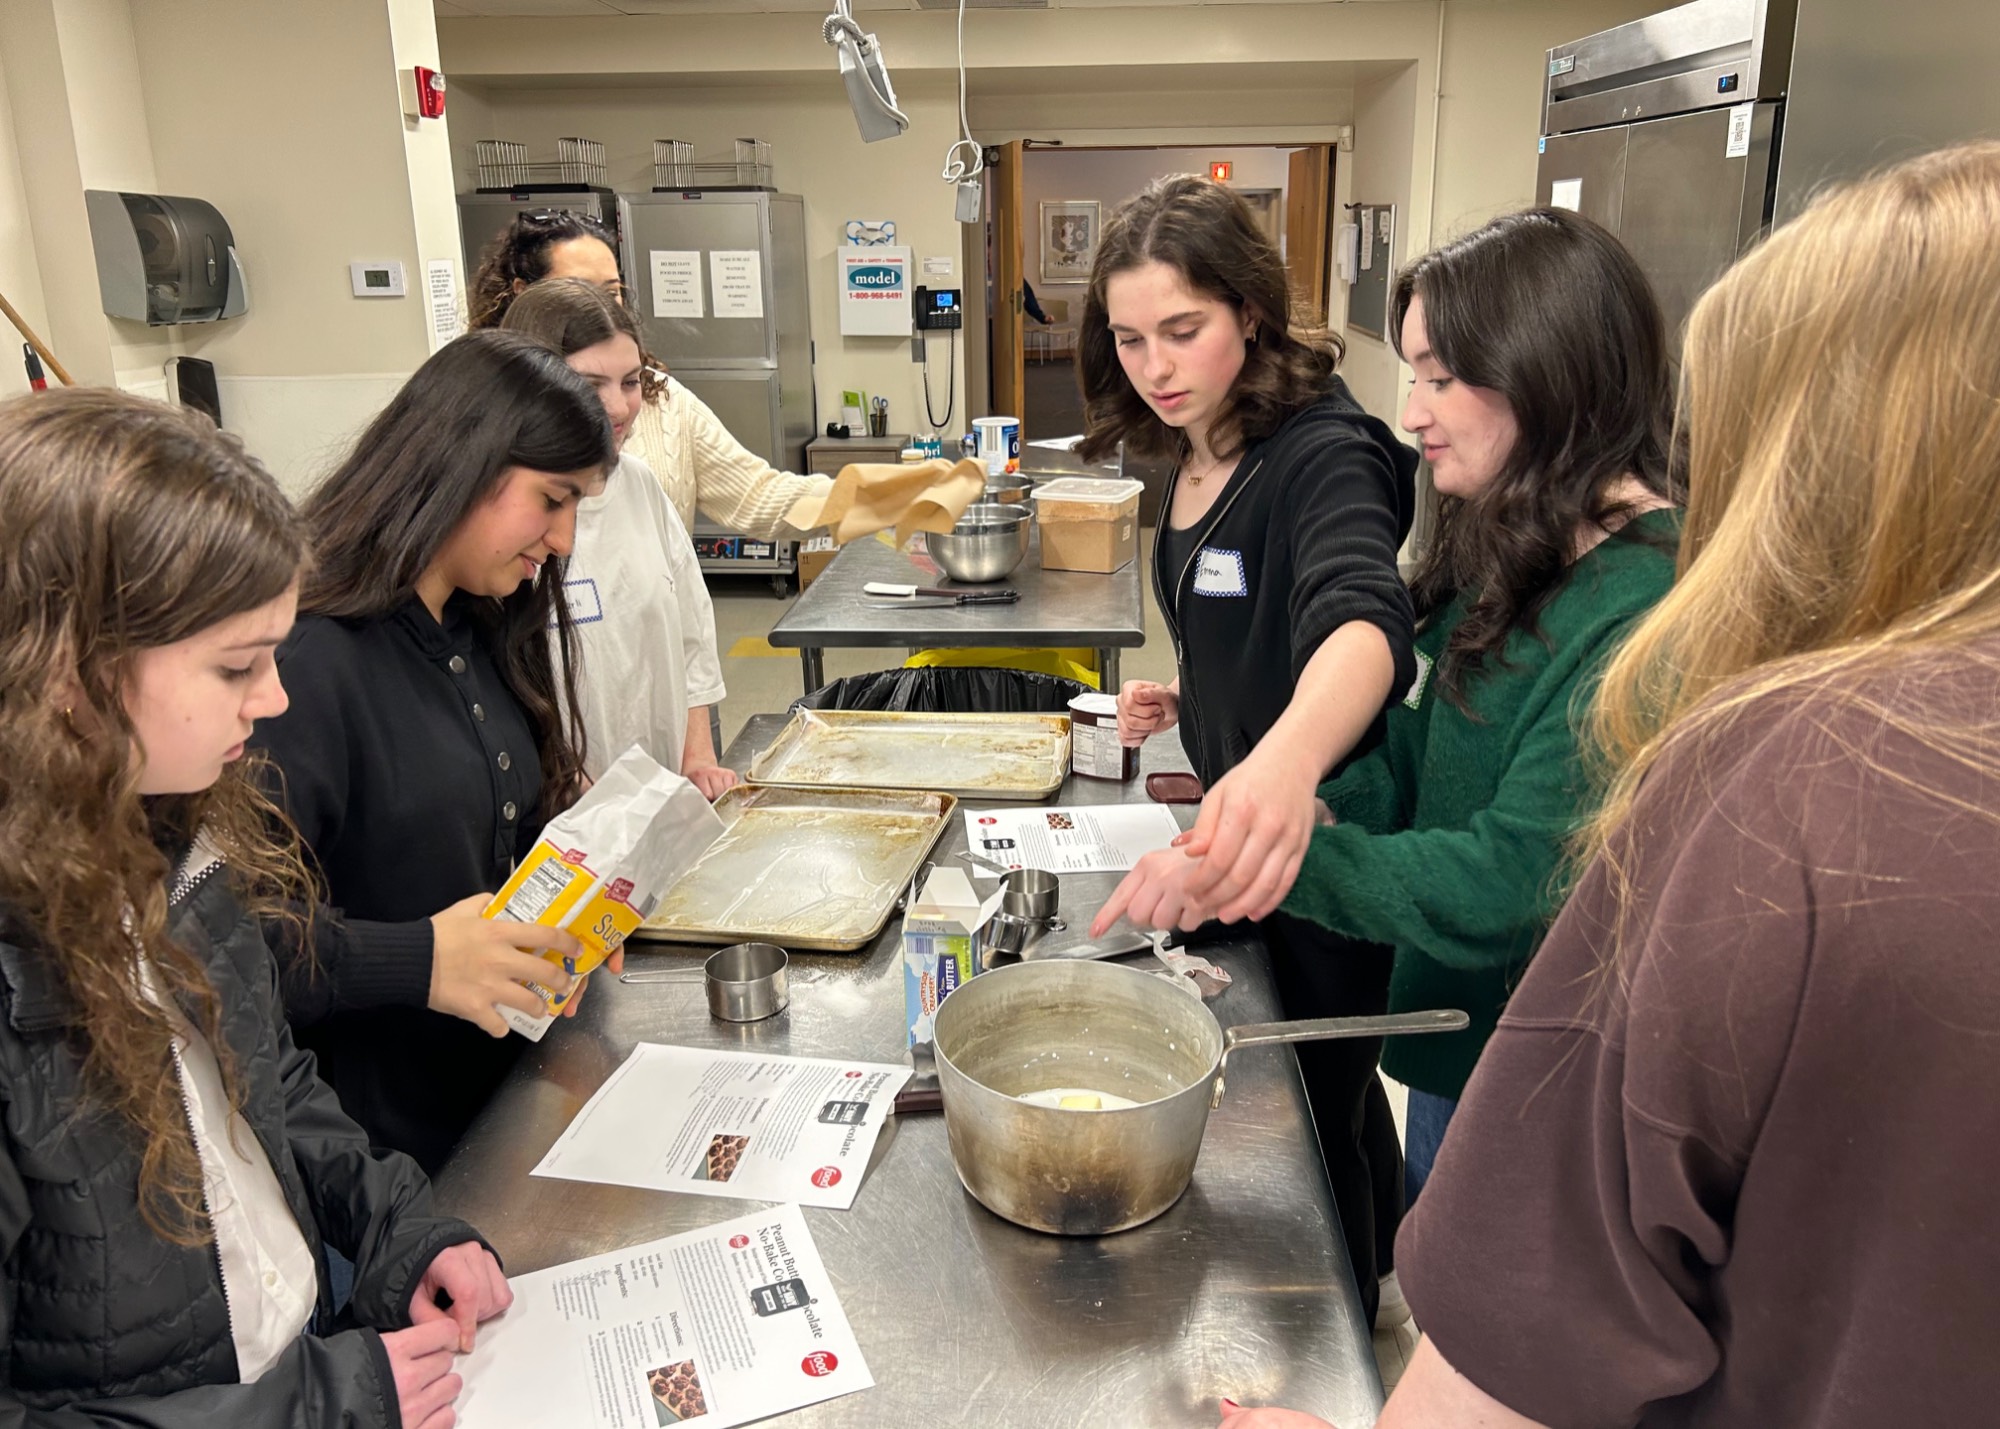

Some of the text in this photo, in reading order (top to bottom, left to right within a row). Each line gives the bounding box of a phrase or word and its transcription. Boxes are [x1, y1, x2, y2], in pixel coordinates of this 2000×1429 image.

[855, 271, 896, 284] model
[593, 914, 625, 950] Sug
[946, 958, 955, 990] BUTTER
[920, 971, 930, 1016] COUNTRYSIDE
[928, 977, 936, 1011] CREAMERY
[757, 1227, 779, 1268] No-Bake
[771, 1223, 790, 1258] Peanut
[614, 1263, 628, 1299] Ingredients:
[670, 1311, 684, 1347] Directions:
[805, 1352, 833, 1375] food
